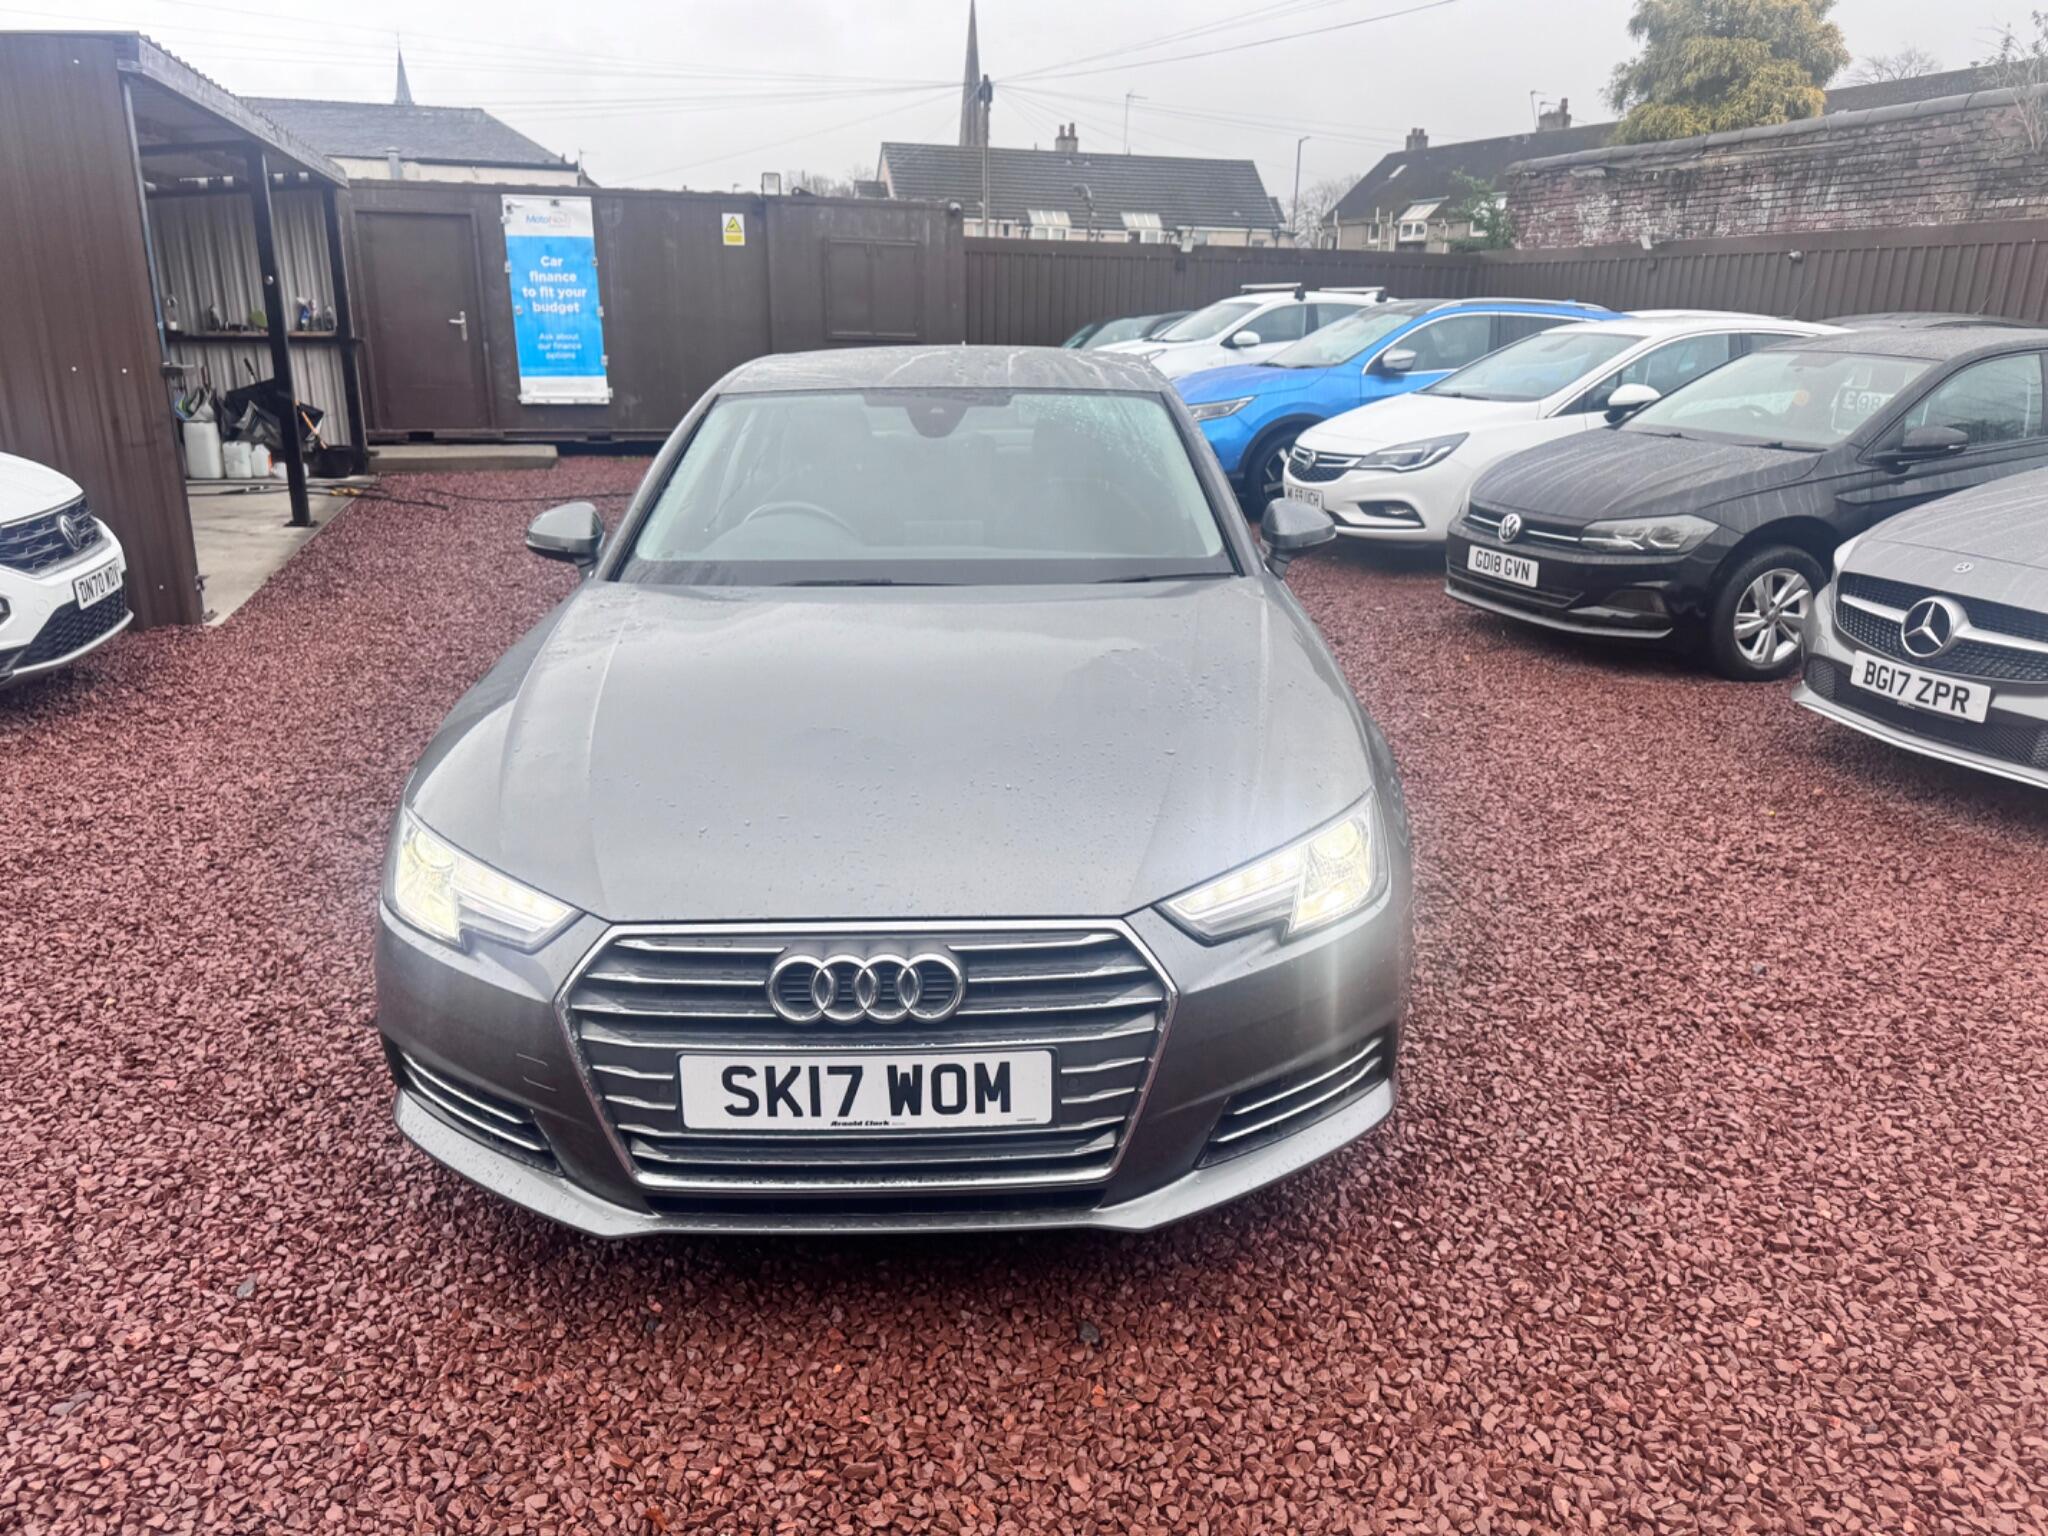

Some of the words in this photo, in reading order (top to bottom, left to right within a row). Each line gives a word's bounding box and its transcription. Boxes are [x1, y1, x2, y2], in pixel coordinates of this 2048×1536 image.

[540, 255, 564, 268] Car
[529, 270, 577, 283] finance
[522, 287, 537, 298] to
[540, 286, 554, 298] fit
[556, 287, 588, 301] your
[532, 300, 580, 316] budget
[539, 332, 554, 341] Ask
[556, 332, 580, 341] about
[537, 342, 552, 351] our
[553, 341, 583, 351] finance
[545, 351, 577, 361] options
[1475, 550, 1502, 573] GD18
[1504, 558, 1531, 581] GVN
[1863, 660, 1911, 696] BG17
[1915, 677, 1970, 714] ZPR
[721, 1064, 864, 1118] SK17
[886, 1060, 1012, 1117] WOM
[864, 1119, 890, 1127] Clark
